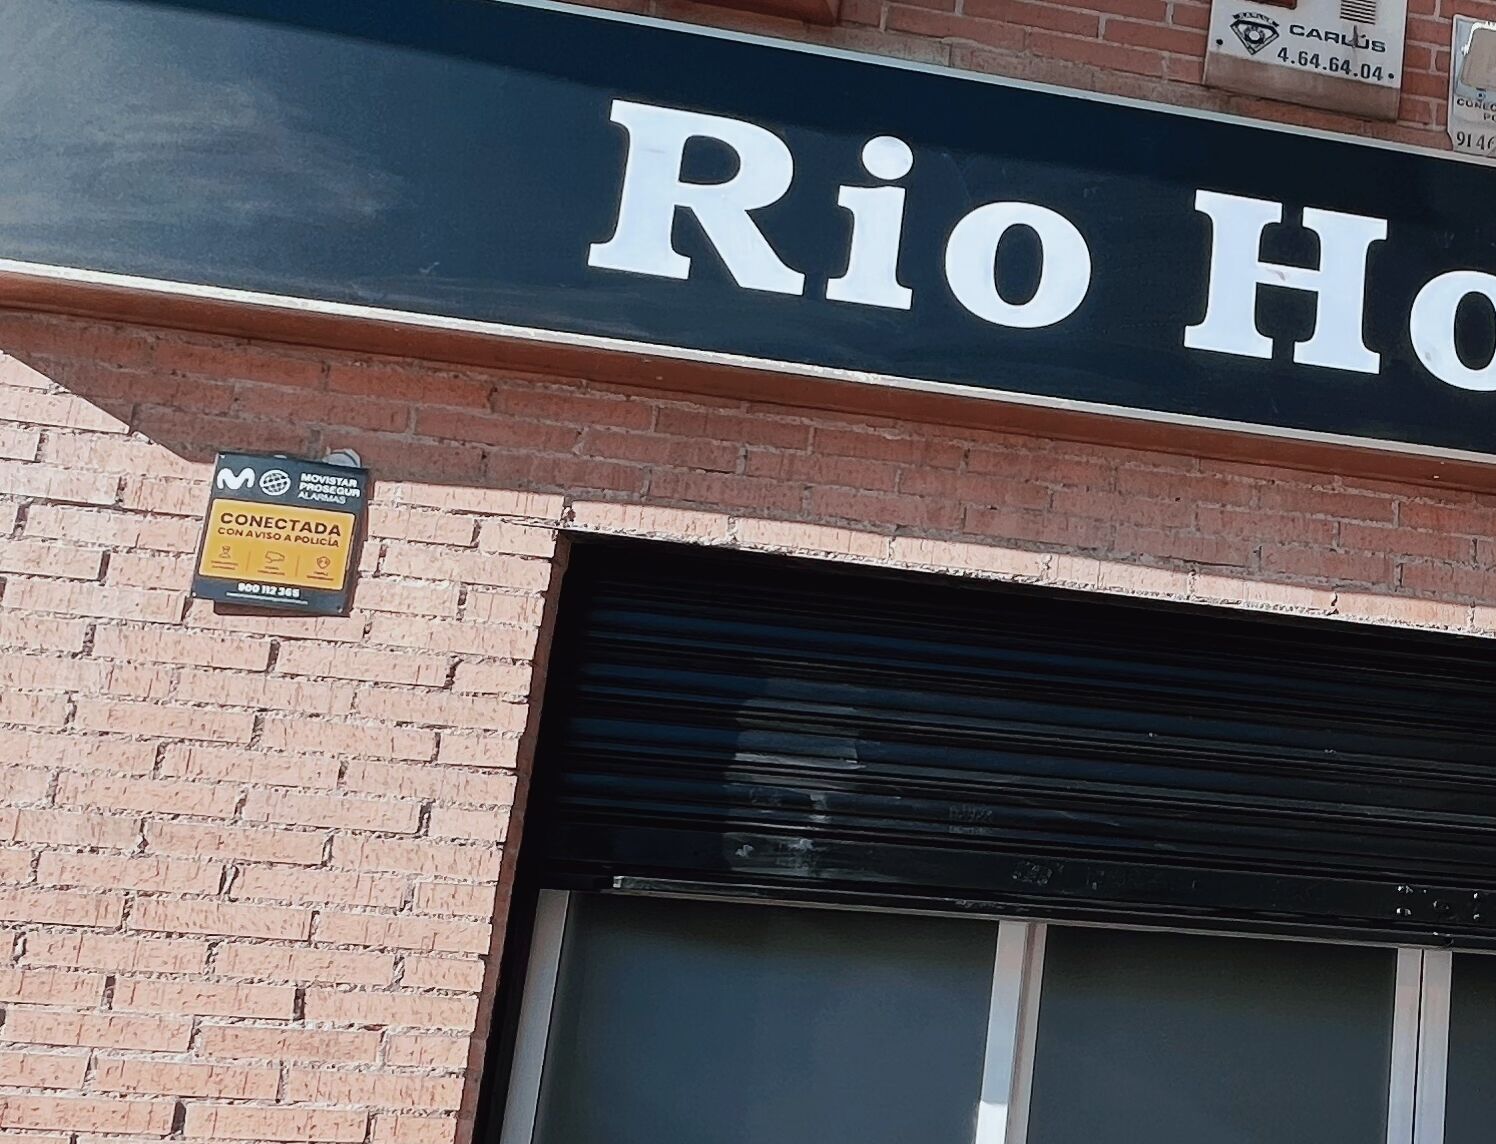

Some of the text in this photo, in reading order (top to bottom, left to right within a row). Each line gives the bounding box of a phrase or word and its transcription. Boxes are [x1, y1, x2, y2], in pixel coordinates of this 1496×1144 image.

[1277, 46, 1383, 81] 4.64.64.04
[588, 99, 1091, 328] Rio
[299, 481, 361, 498] PROSEGUR
[300, 473, 358, 488] MOVISTAR
[297, 490, 346, 505] ALARMAS
[220, 512, 341, 537] CONECTADA
[217, 527, 339, 548] CON AVISO A POLICÍA
[237, 582, 300, 598] 900 112 365
